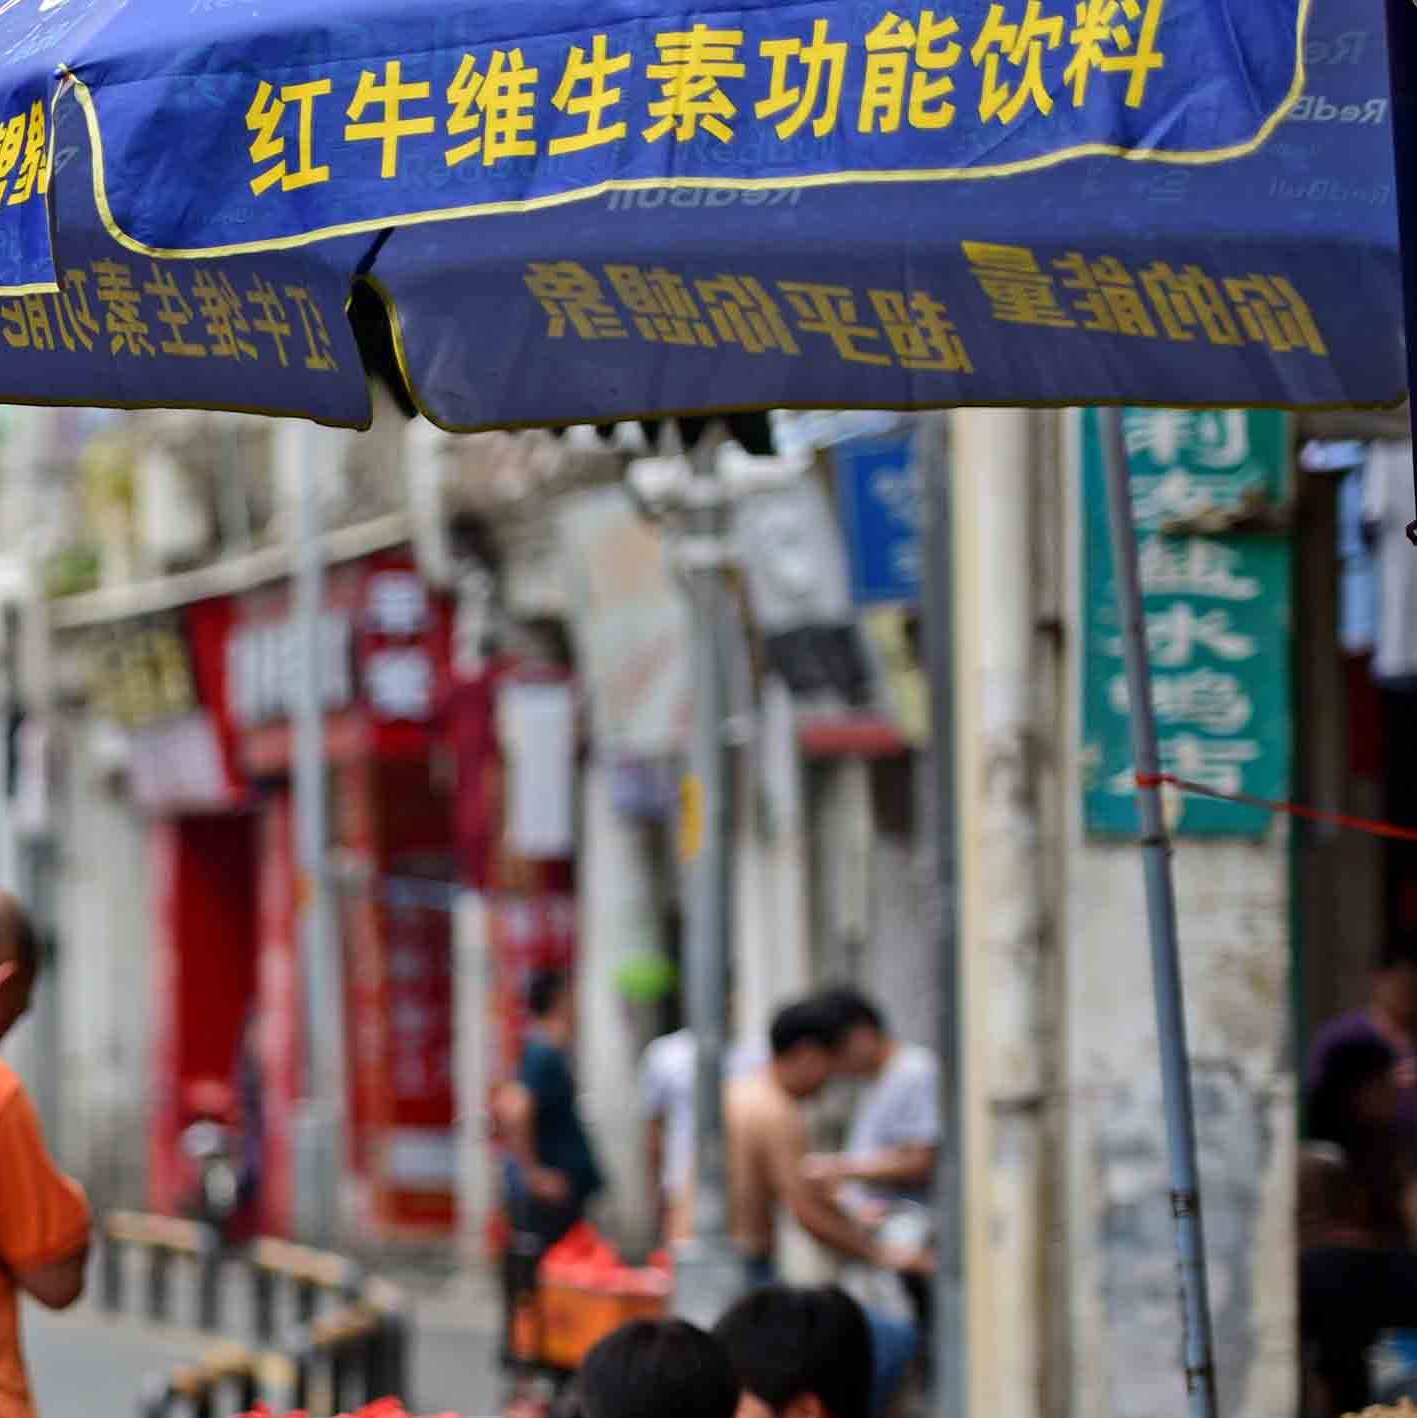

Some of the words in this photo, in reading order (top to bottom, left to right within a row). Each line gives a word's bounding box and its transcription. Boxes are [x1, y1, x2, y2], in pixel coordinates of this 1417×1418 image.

[245, 0, 1164, 197] 红牛维生素功能饮料
